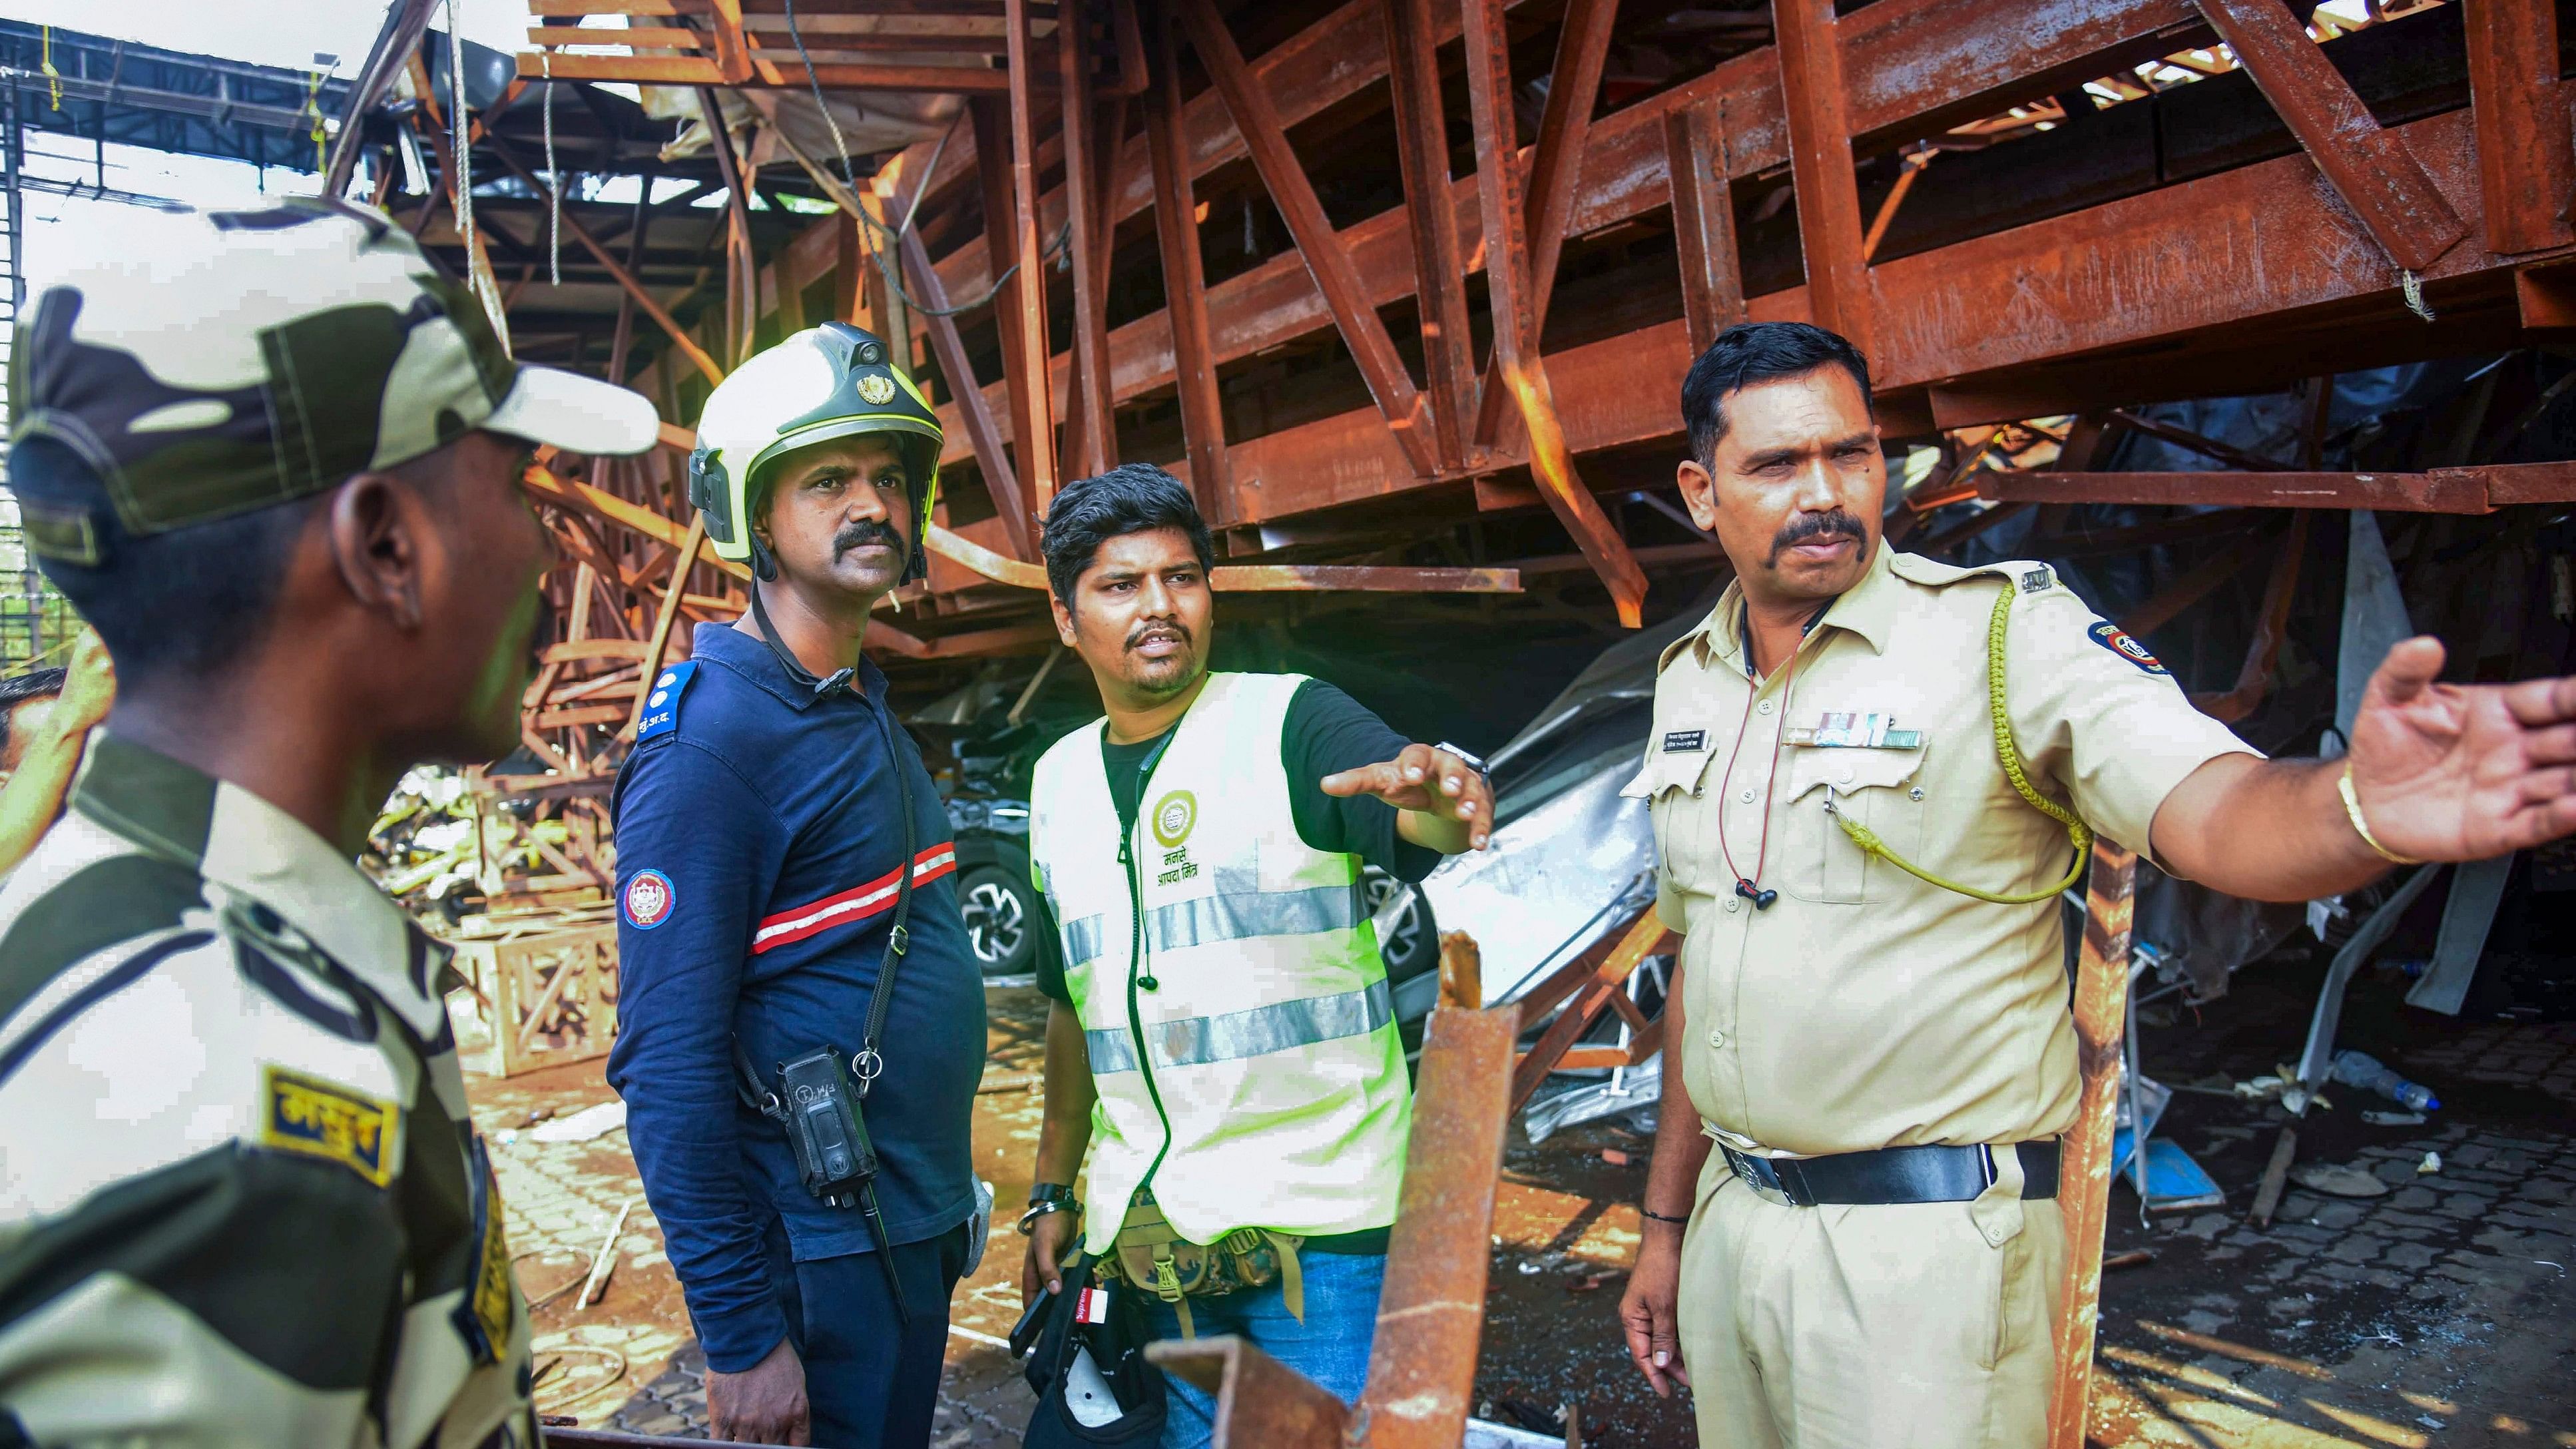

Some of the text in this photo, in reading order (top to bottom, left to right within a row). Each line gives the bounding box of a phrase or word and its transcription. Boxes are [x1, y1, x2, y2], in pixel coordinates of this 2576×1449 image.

[1163, 846, 1186, 866] मनसे
[1158, 862, 1198, 886] आपदा मित्र
[1076, 1288, 1087, 1320] Supreme
